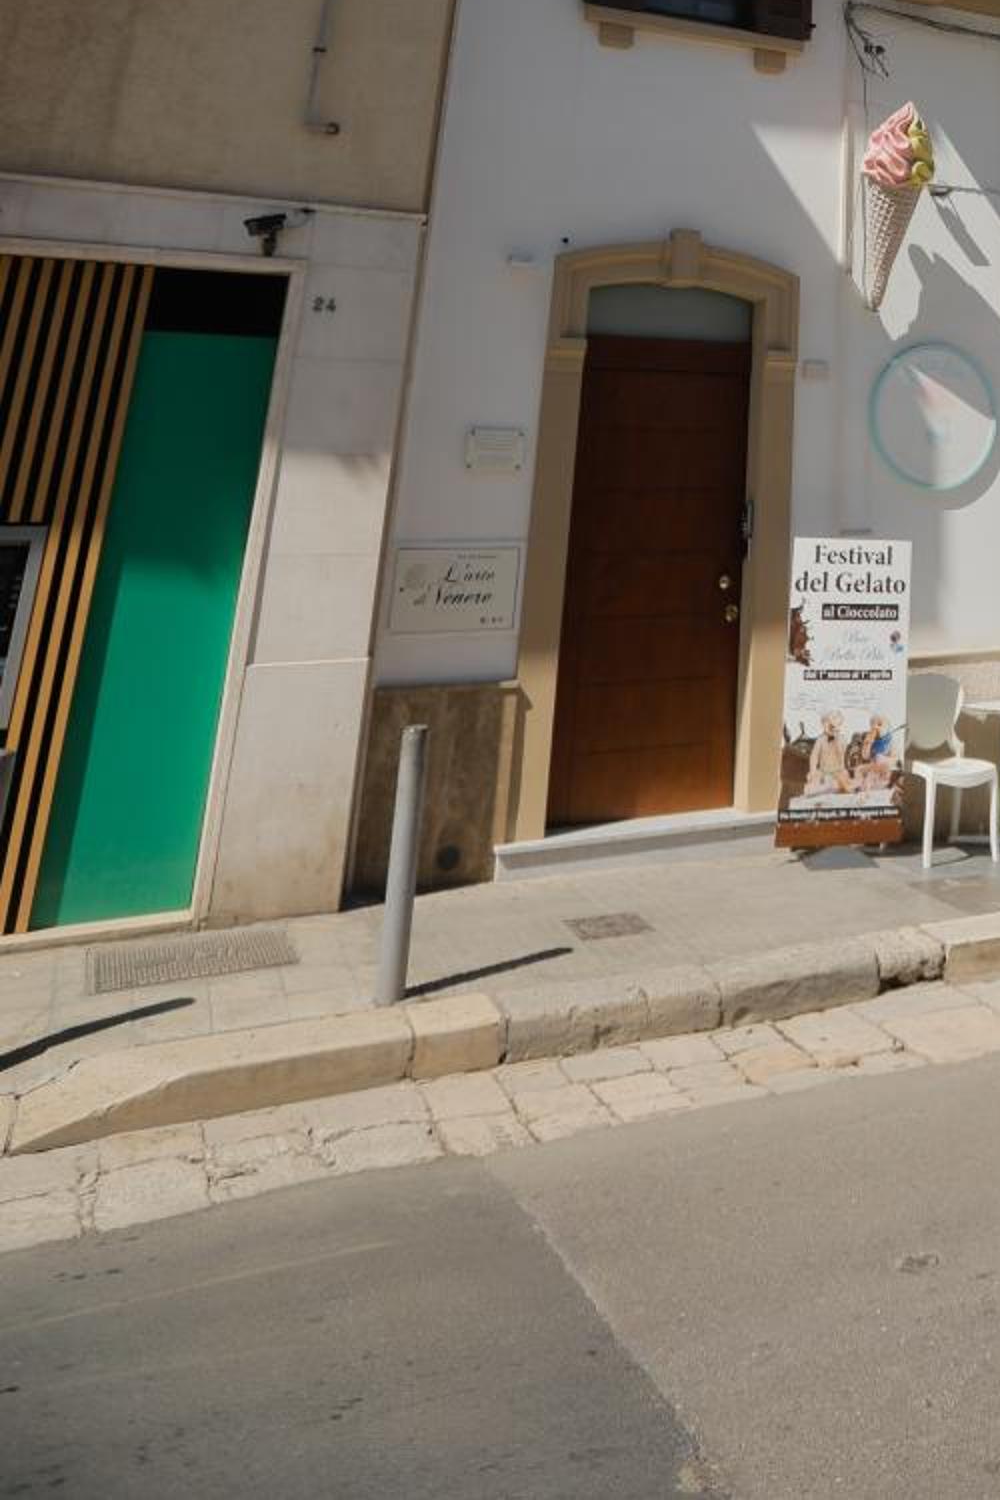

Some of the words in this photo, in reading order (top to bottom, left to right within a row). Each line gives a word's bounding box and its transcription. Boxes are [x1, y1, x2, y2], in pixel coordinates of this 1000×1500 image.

[312, 296, 337, 313] 24
[815, 544, 892, 565] Festival
[795, 571, 828, 592] del
[835, 571, 906, 594] Gelato
[823, 605, 835, 618] al
[837, 605, 897, 619] Cioccolato
